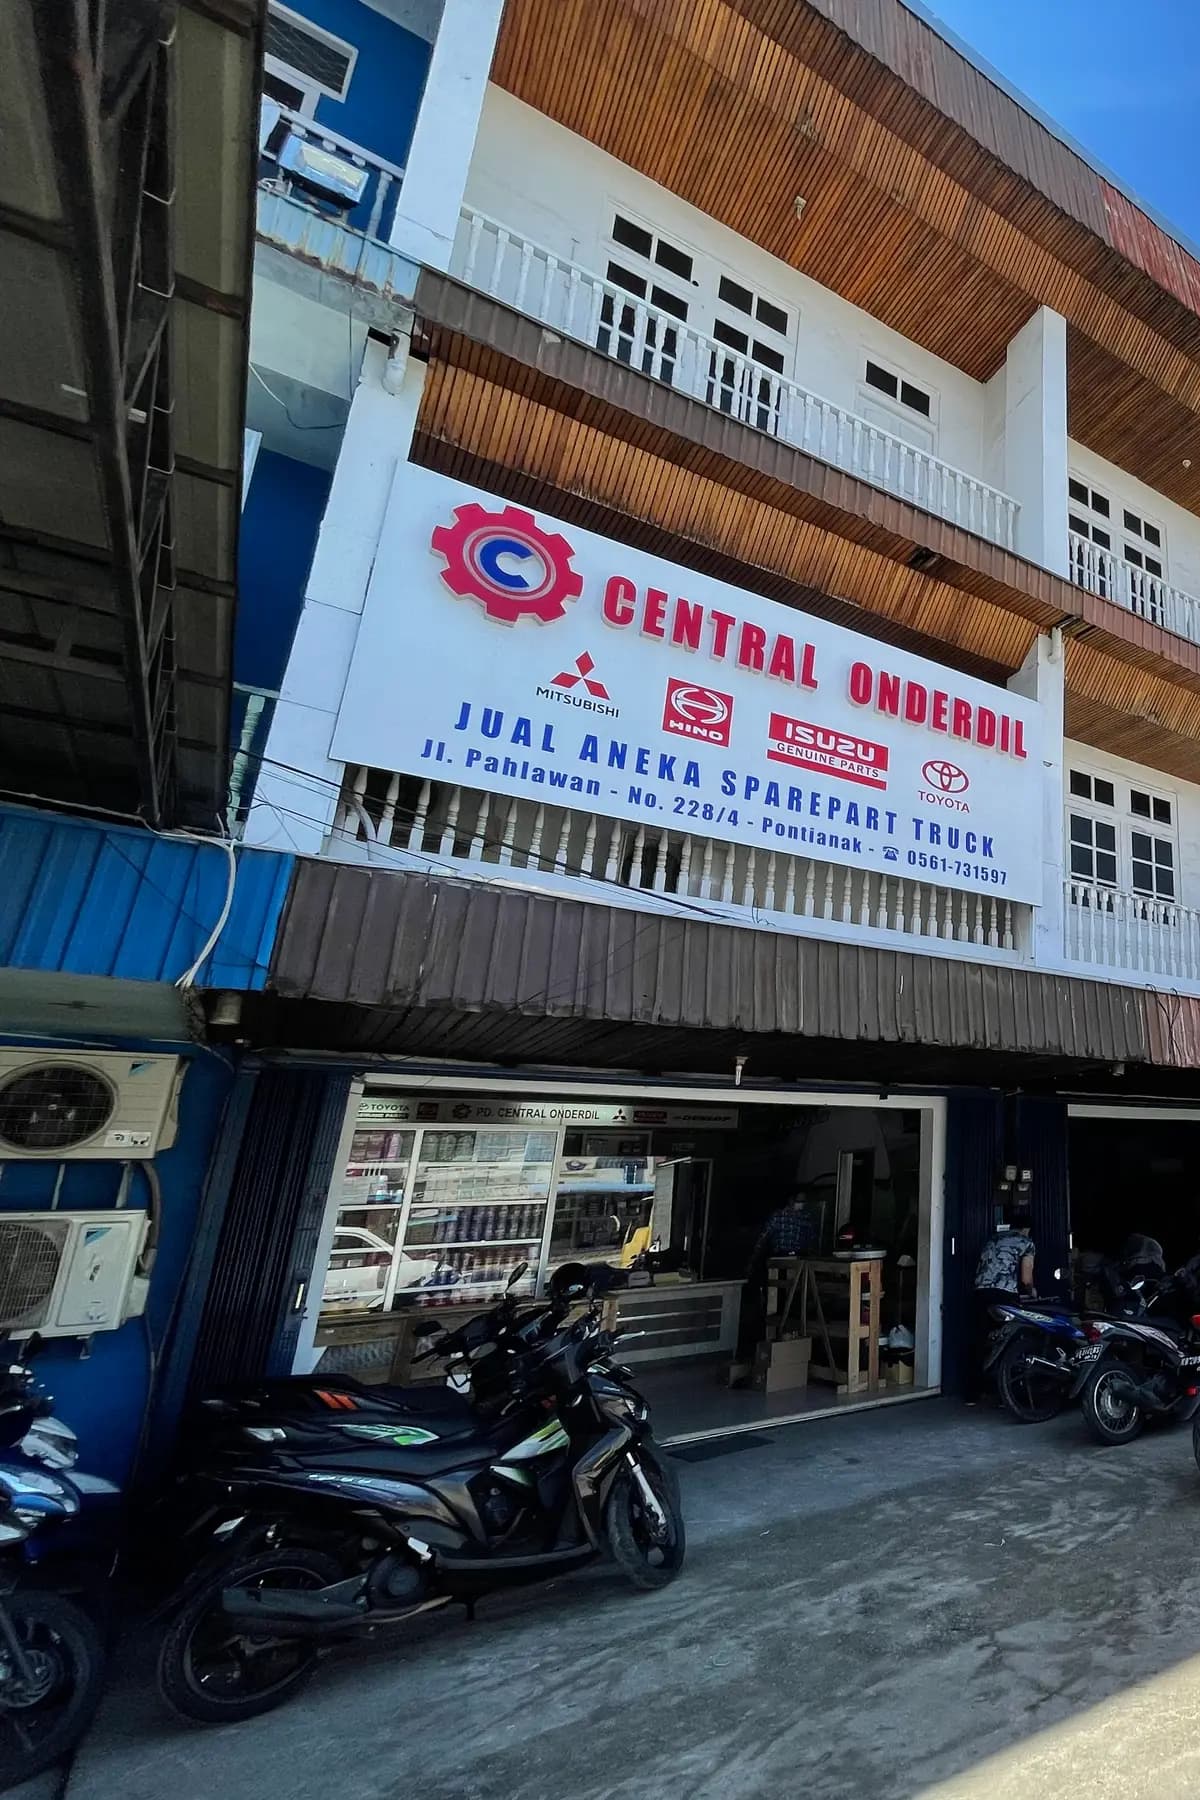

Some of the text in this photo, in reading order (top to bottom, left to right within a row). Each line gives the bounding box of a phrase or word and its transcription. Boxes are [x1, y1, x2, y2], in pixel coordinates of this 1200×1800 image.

[603, 575, 1029, 760] CENTRAL ONDERDIL
[536, 686, 620, 718] MITSUBISHI
[669, 719, 724, 742] HINO
[785, 721, 875, 762] ISUZU
[777, 742, 880, 778] GENUINE PARTS
[454, 701, 995, 858] JUAL ANEKA SPAREPART TRUCK
[465, 747, 601, 796] Pahlawan
[628, 785, 663, 811] No.
[673, 796, 739, 827] 228/4
[762, 816, 862, 854] Pontianak
[907, 849, 1007, 886] 0561-731597
[917, 790, 971, 814] TOYOTA
[370, 1103, 410, 1112] TOYOTA
[497, 1107, 547, 1119] CENTRAL
[549, 1108, 600, 1120] ONDERDIL
